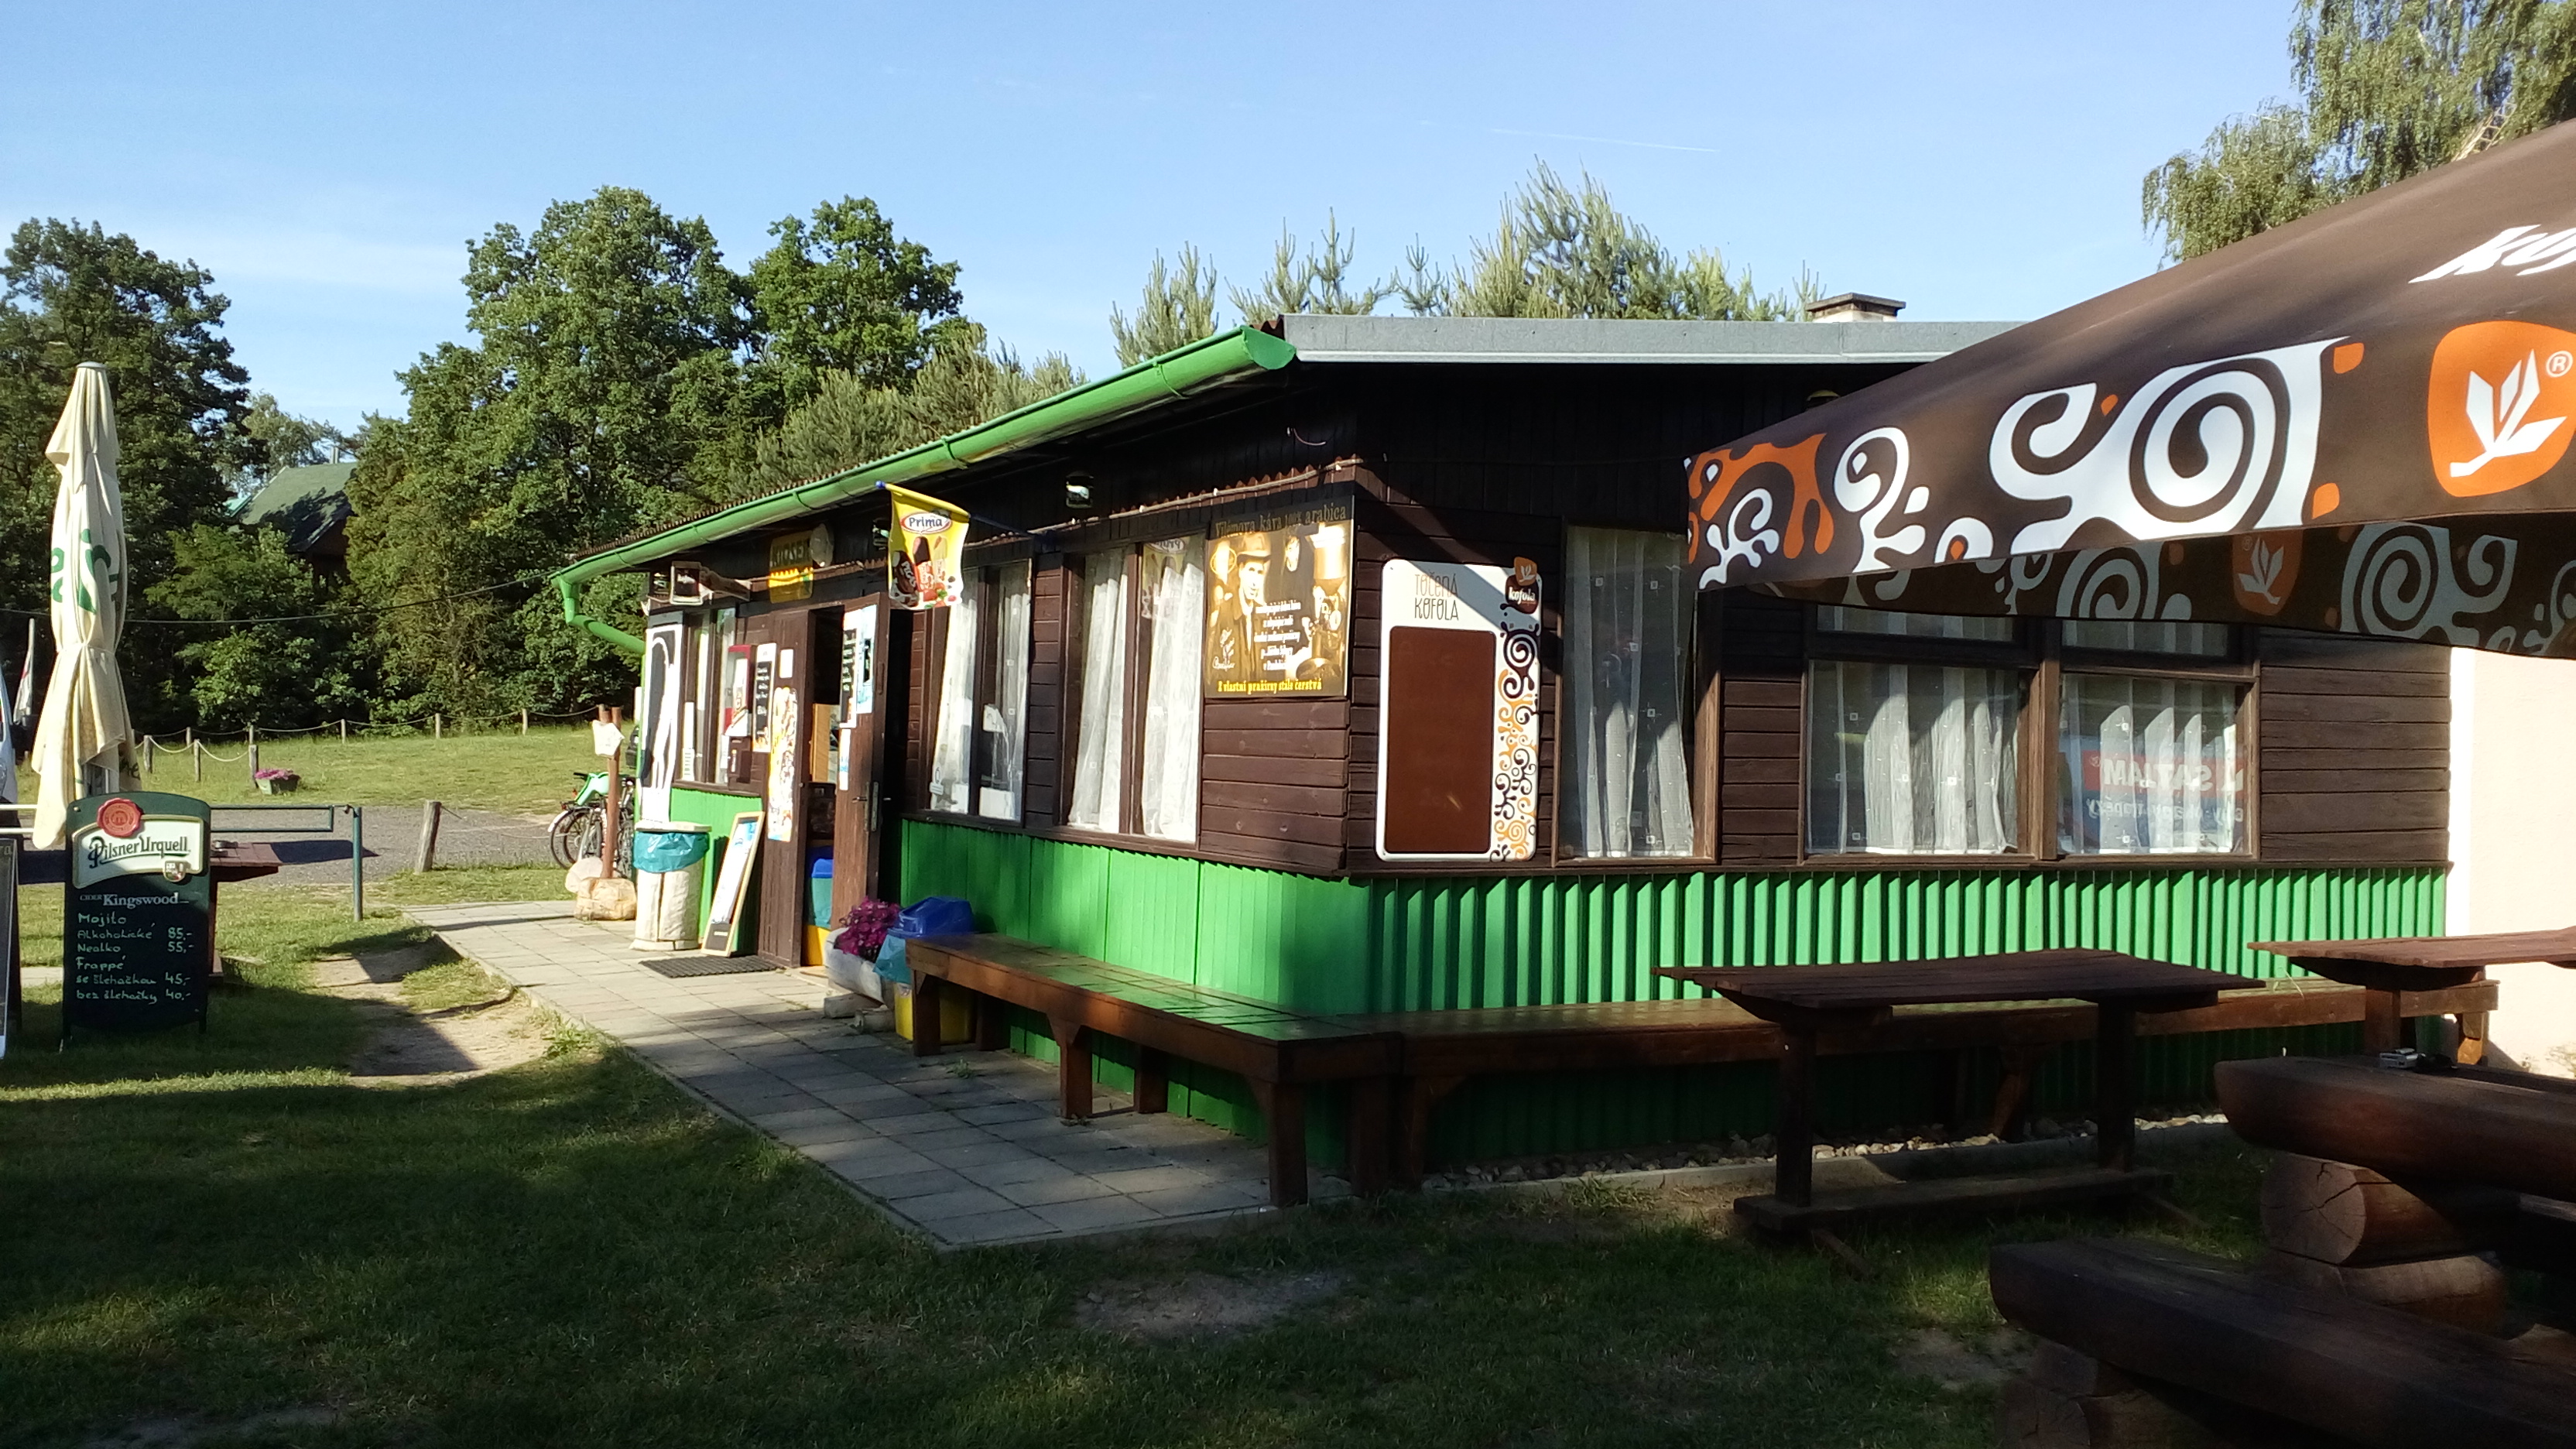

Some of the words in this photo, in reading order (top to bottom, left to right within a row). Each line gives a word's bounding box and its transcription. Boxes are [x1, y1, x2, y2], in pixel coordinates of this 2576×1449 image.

[1305, 502, 1347, 524] arabica
[909, 516, 943, 527] Prima
[1509, 587, 1536, 605] kofola
[1415, 598, 1458, 621] KOFOLA
[1223, 680, 1247, 692] vlastní
[1295, 677, 1322, 690] čerstvá
[87, 836, 139, 868] Pilsner
[139, 835, 187, 859] Urquell
[103, 892, 179, 909] Kingswood
[78, 911, 126, 927] Mojito
[77, 942, 121, 952] Nealko
[76, 955, 125, 971] Frappé
[77, 990, 99, 999] bez
